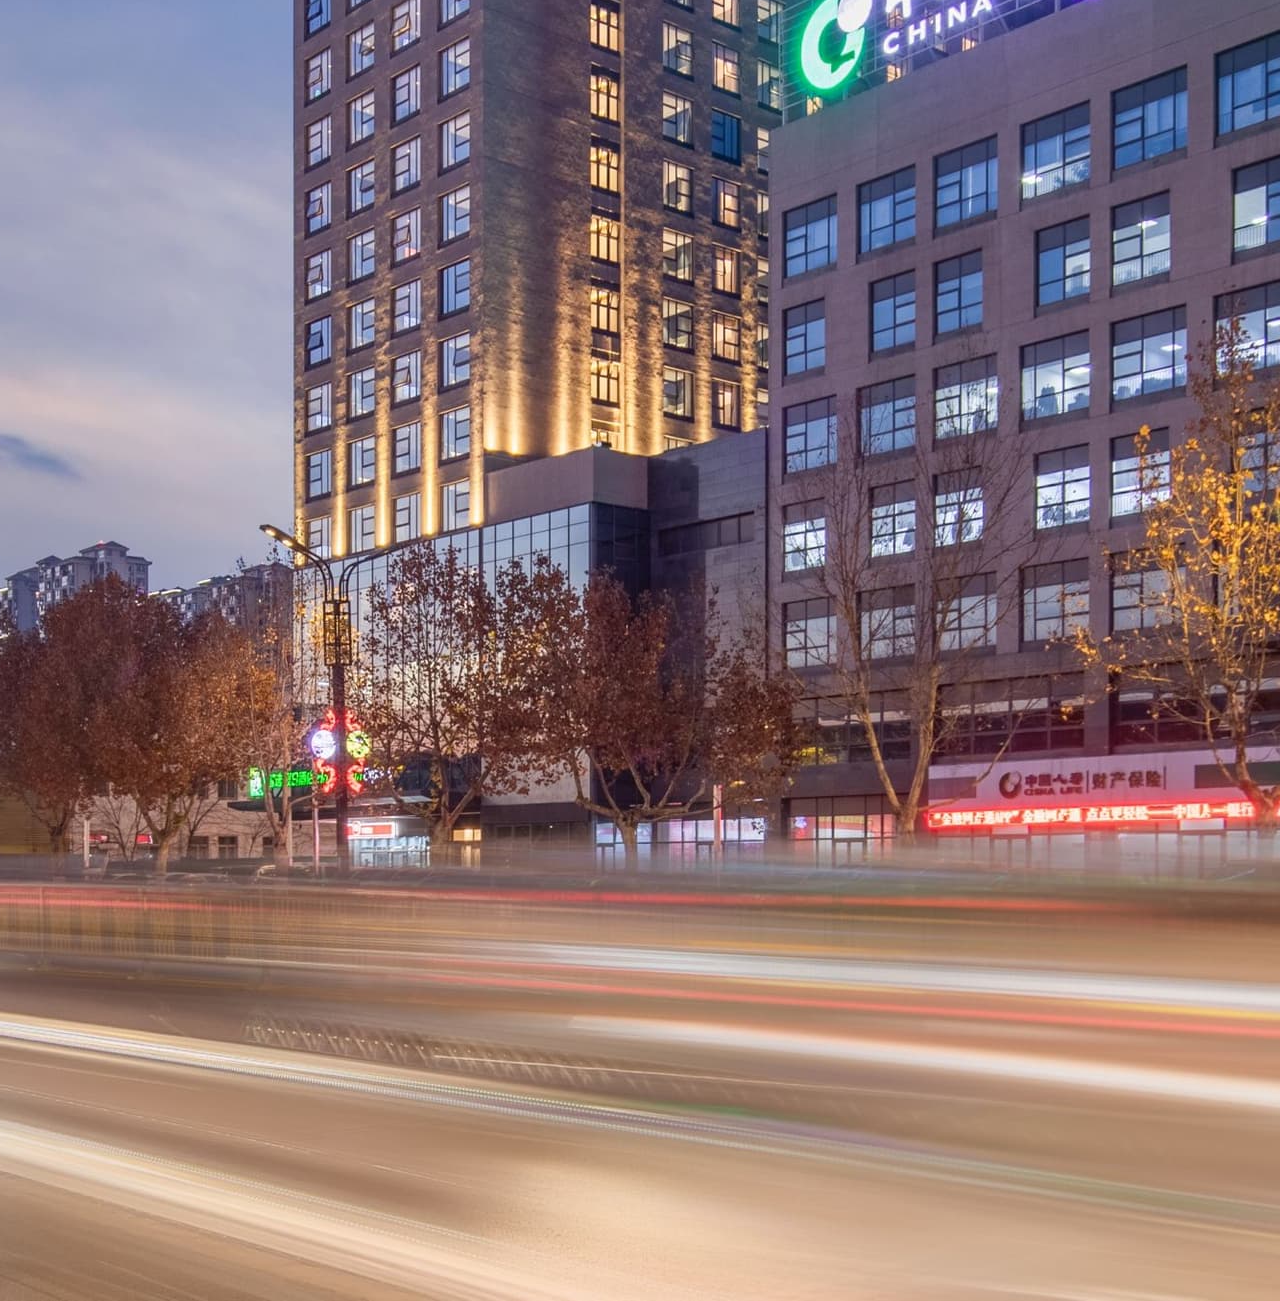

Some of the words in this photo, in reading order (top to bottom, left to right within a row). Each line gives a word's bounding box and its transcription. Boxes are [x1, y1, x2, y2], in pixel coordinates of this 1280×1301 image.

[1024, 772, 1084, 789] 中国人寿
[1091, 770, 1162, 790] 财产保险
